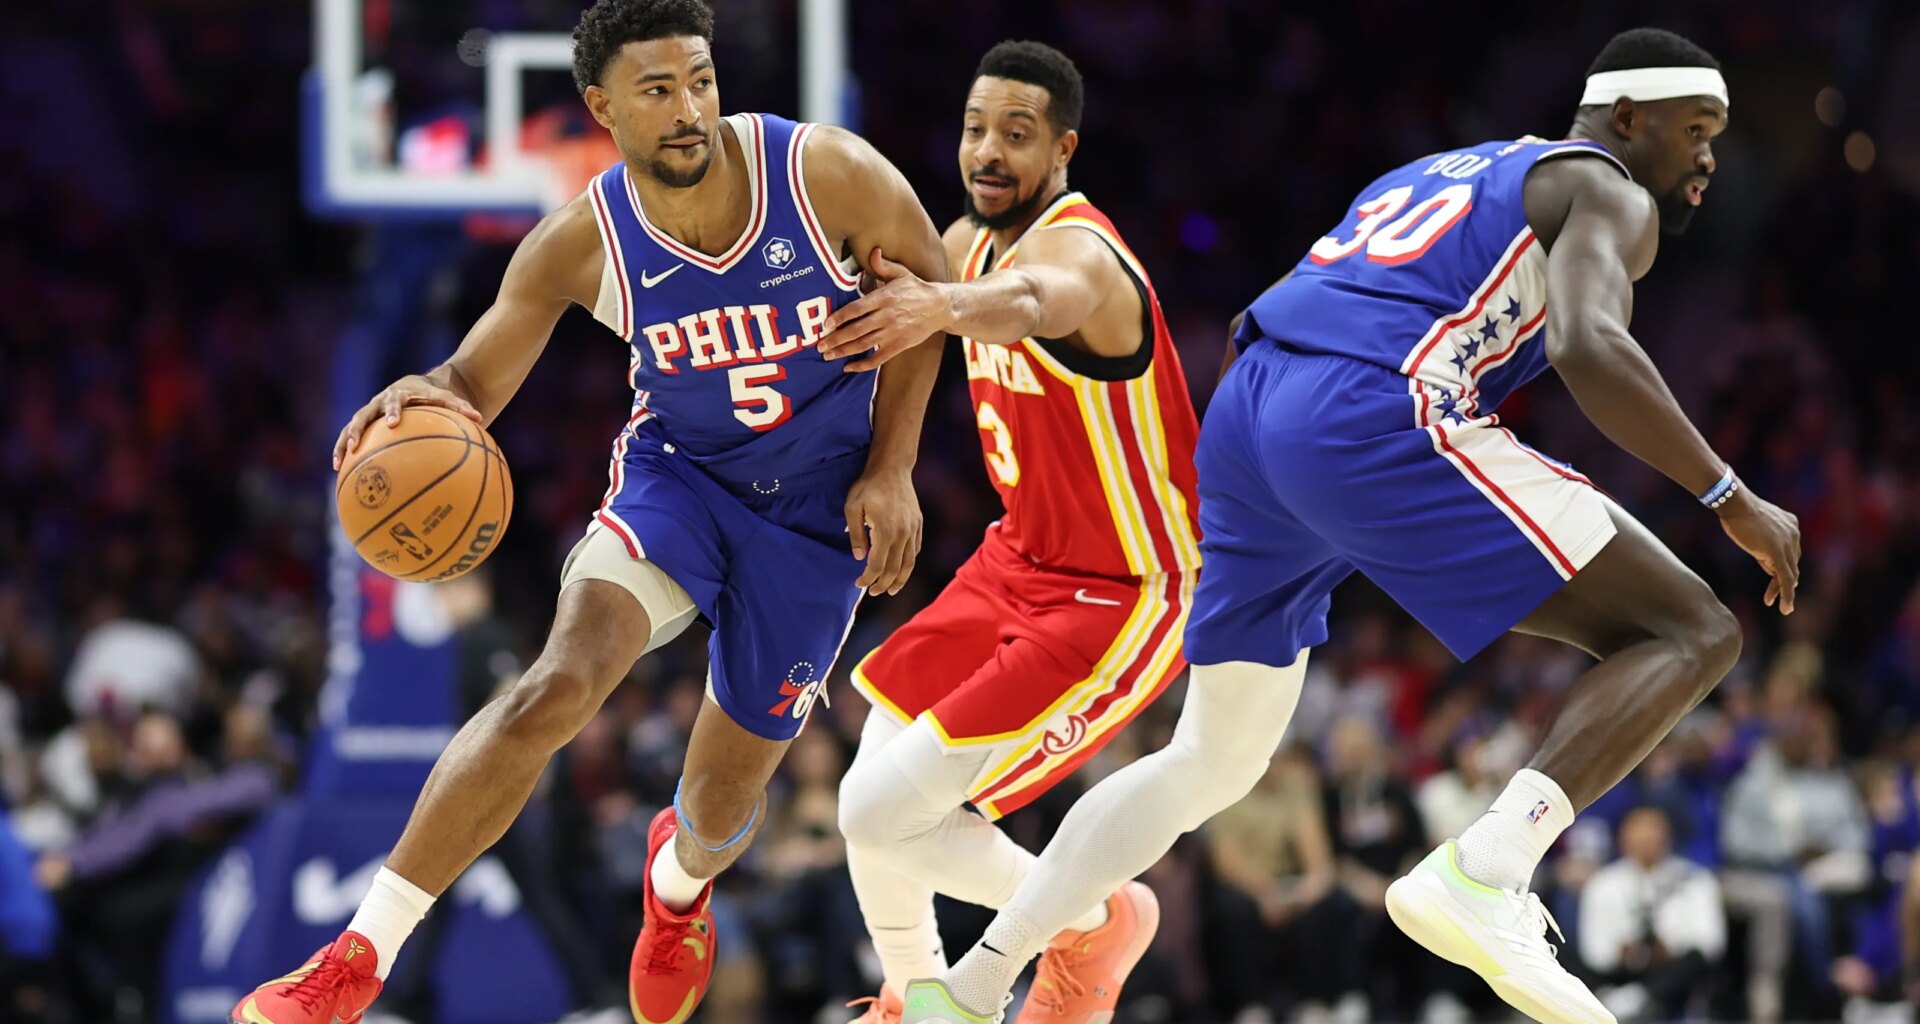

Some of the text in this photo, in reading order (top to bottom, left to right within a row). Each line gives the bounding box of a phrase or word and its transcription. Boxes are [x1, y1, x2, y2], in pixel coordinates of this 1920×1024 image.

[1310, 184, 1473, 266] 30
[760, 265, 814, 289] crypto.com
[642, 296, 832, 374] PHILA
[727, 363, 793, 432] 5
[977, 401, 1021, 487] 3
